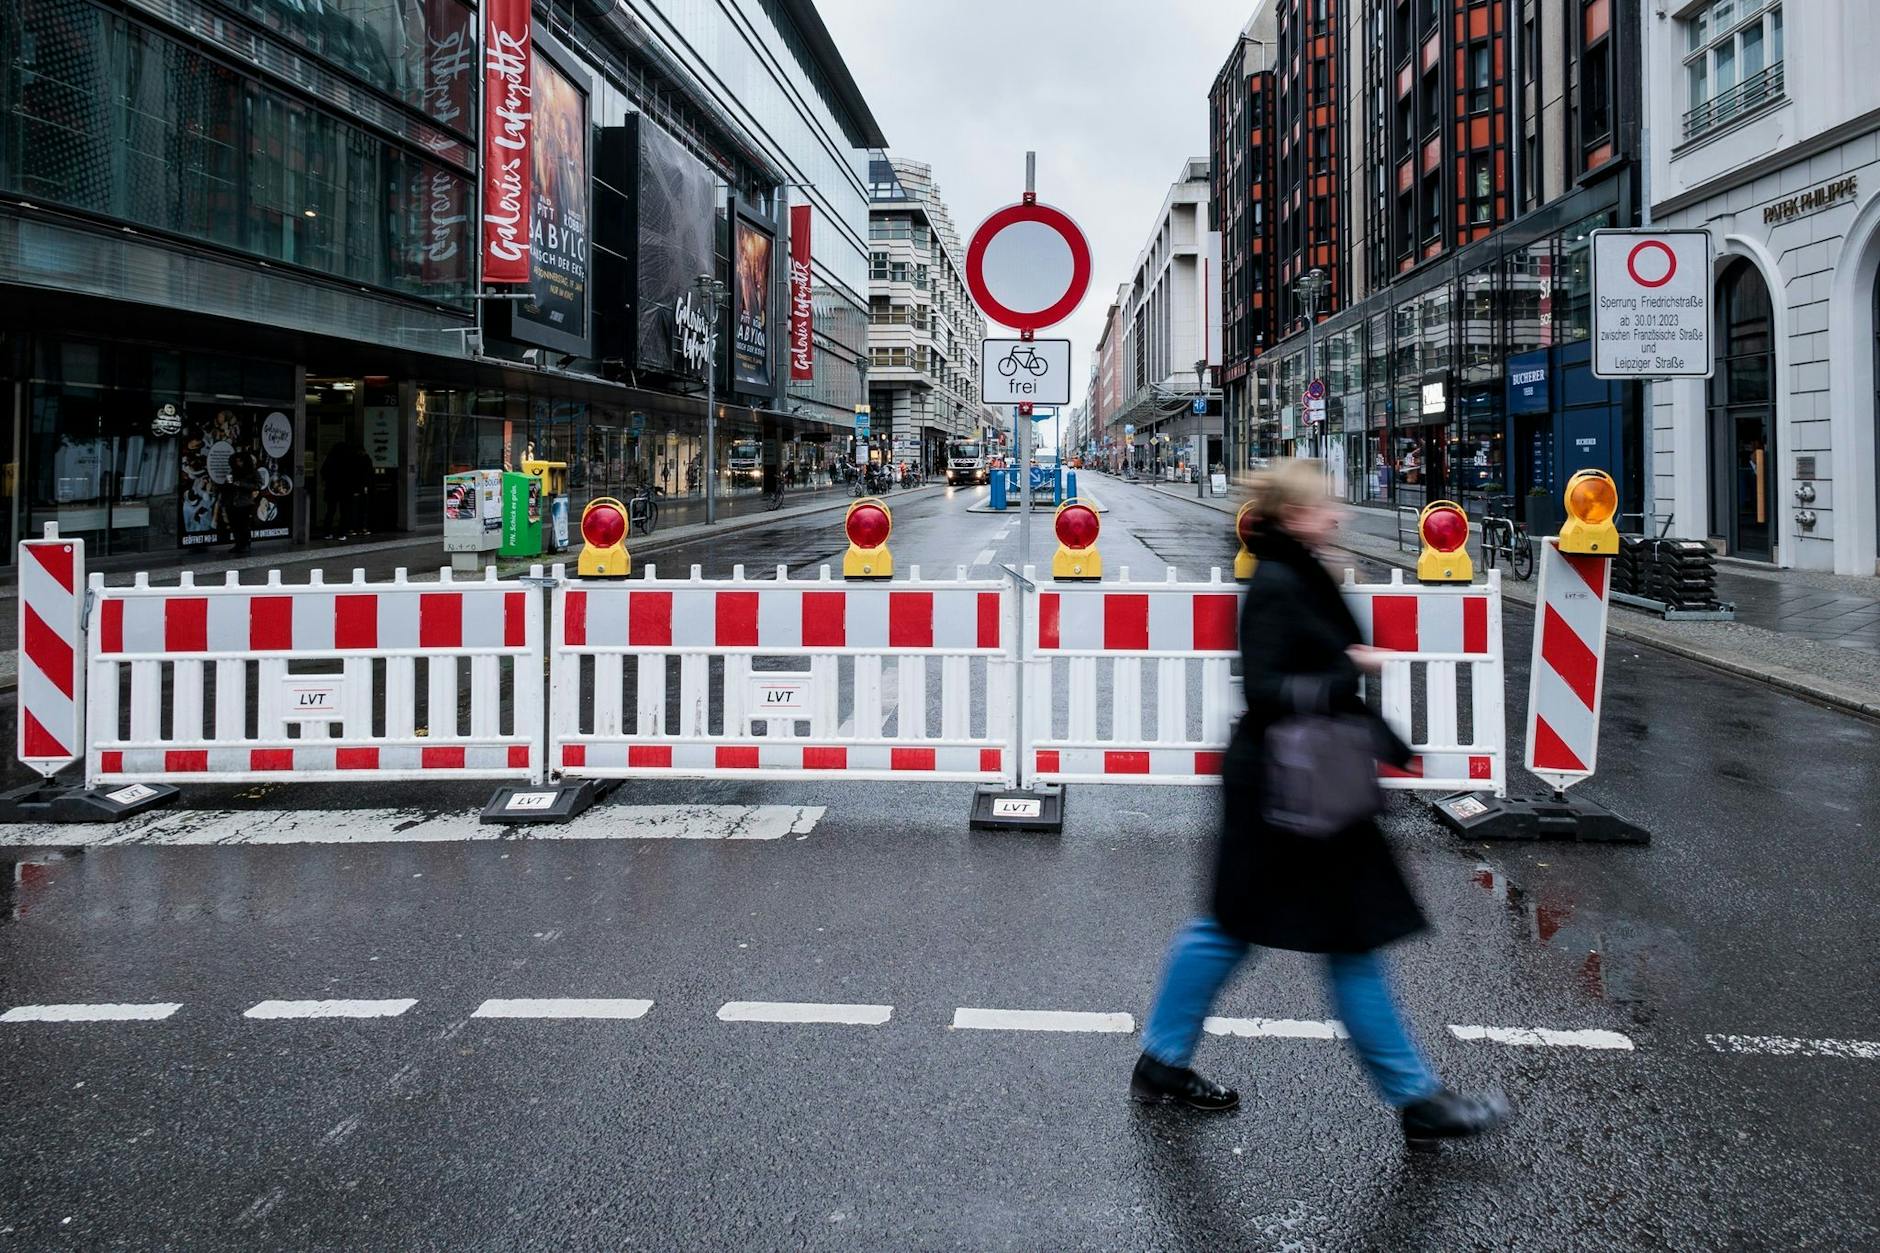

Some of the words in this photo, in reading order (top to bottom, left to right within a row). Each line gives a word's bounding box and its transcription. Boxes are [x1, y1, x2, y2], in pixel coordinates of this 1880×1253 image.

[486, 20, 533, 150] Lafayette
[1763, 196, 1800, 225] PATEK
[1800, 174, 1858, 212] PHILIPPE
[482, 158, 532, 262] Galeries
[790, 258, 814, 318] Lafayette
[1600, 296, 1637, 310] Sperrung
[1641, 295, 1703, 308] Friedrichstraße
[675, 291, 706, 336] Galeries
[1619, 315, 1630, 327] ab
[1634, 314, 1679, 327] 30.01.2023
[1600, 329, 1631, 341] zwischen
[1633, 328, 1676, 341] Französische
[1679, 328, 1703, 341] Straße
[789, 321, 813, 370] Galeries
[1641, 343, 1657, 353] und
[1614, 356, 1651, 372] Leipziger
[1655, 356, 1685, 369] Straße
[1512, 369, 1545, 386] BUCHERER
[1009, 378, 1037, 394] frei
[300, 693, 327, 705] LVT
[768, 691, 794, 703] LVT
[517, 797, 546, 805] LVT
[1003, 803, 1031, 812] LVT
